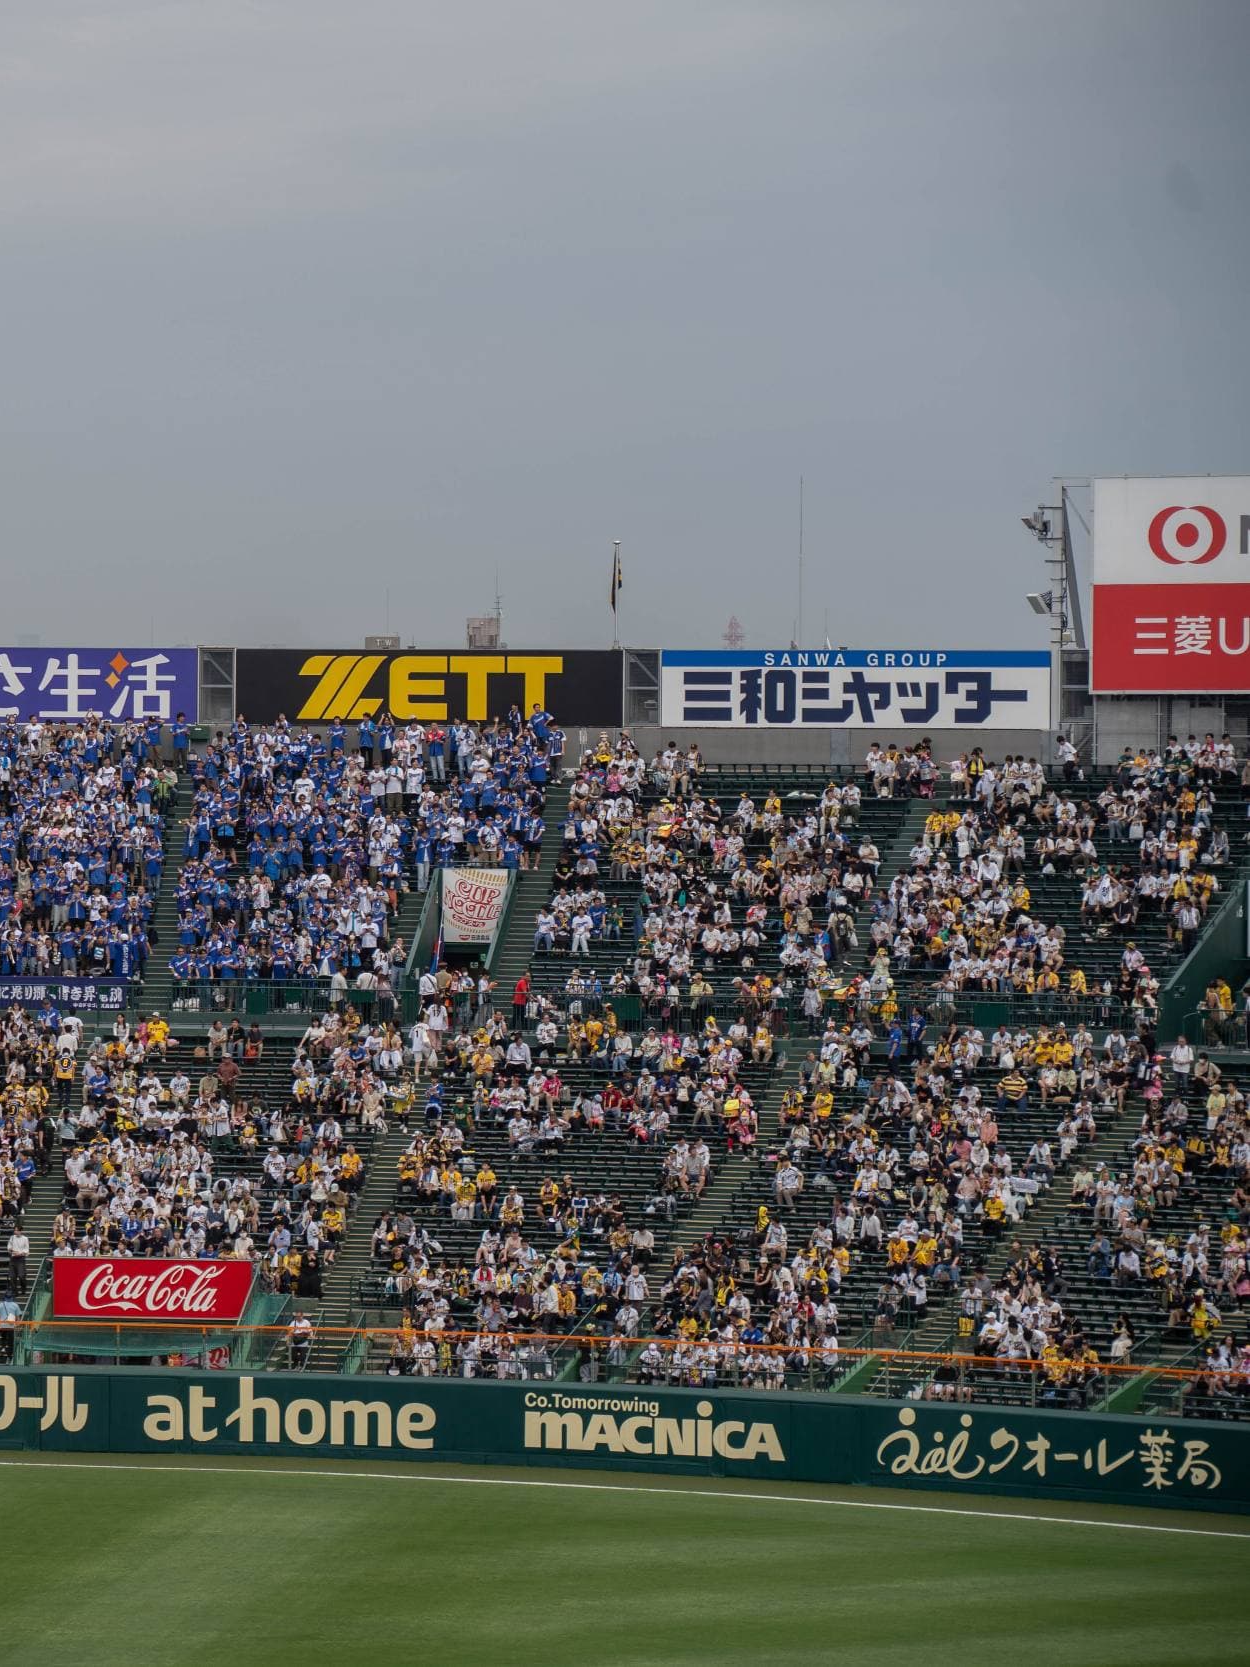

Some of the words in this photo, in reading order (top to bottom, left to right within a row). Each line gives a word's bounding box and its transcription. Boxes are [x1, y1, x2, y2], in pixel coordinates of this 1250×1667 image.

[296, 655, 563, 721] ZETT
[764, 652, 847, 667] SANWA
[867, 652, 948, 667] GROUP
[683, 668, 1028, 724] 三和シャッター
[78, 1263, 226, 1312] Coca-Cola
[143, 1385, 218, 1442] at
[225, 1376, 437, 1450] home
[988, 1427, 1222, 1490] クオール薬局
